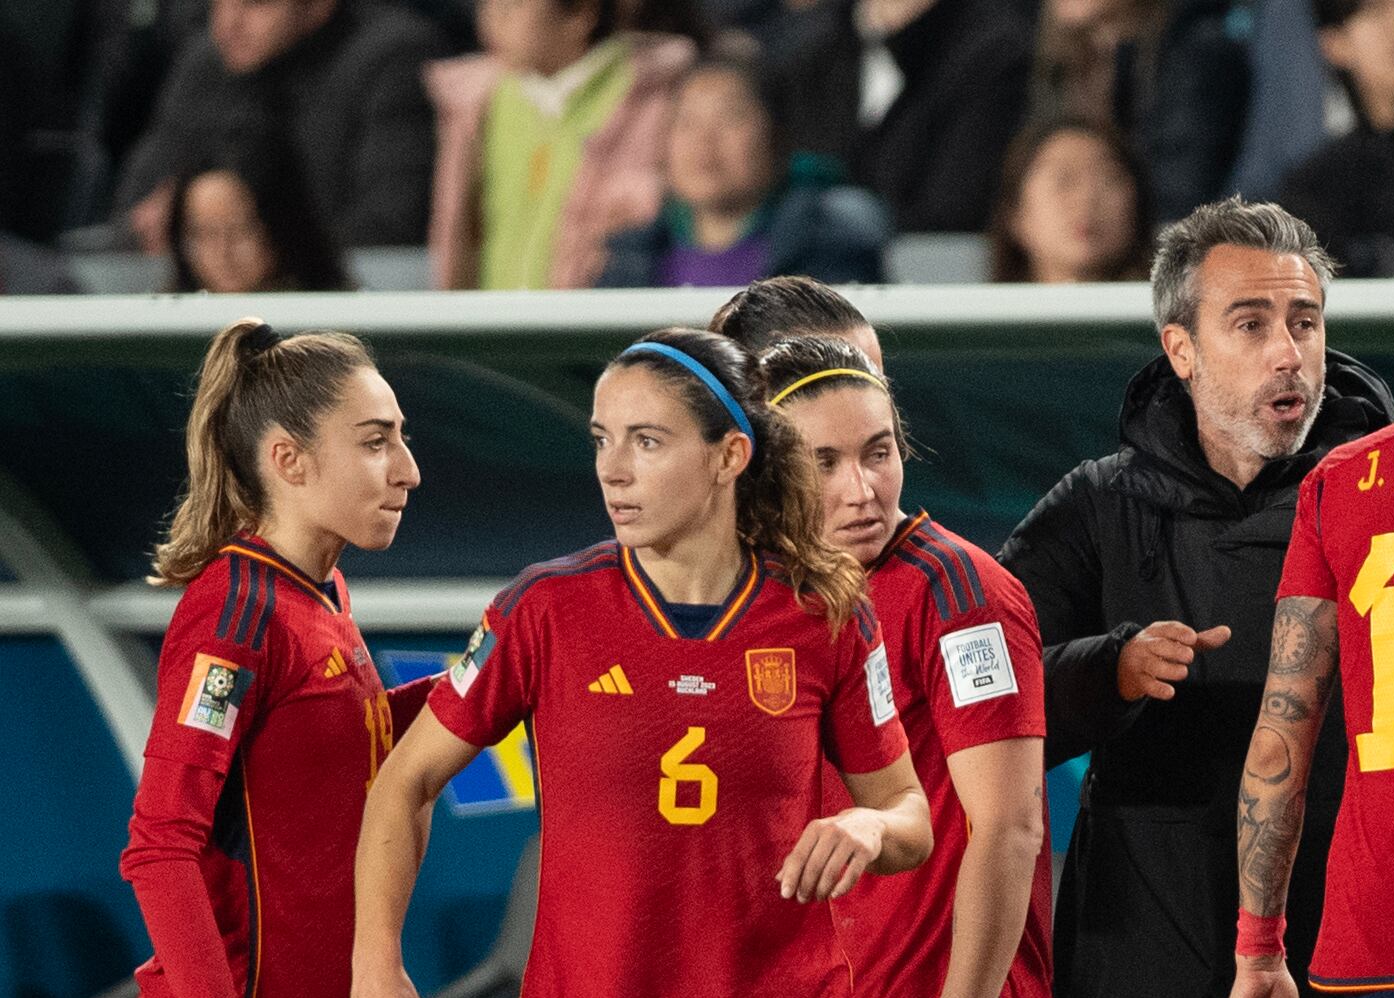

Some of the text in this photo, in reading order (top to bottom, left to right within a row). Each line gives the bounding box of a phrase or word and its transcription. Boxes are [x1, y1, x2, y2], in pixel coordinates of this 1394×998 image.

[1357, 449, 1385, 491] J.
[956, 638, 992, 653] FOOTBALL
[959, 648, 996, 667] UNITES
[658, 727, 718, 825] 6
